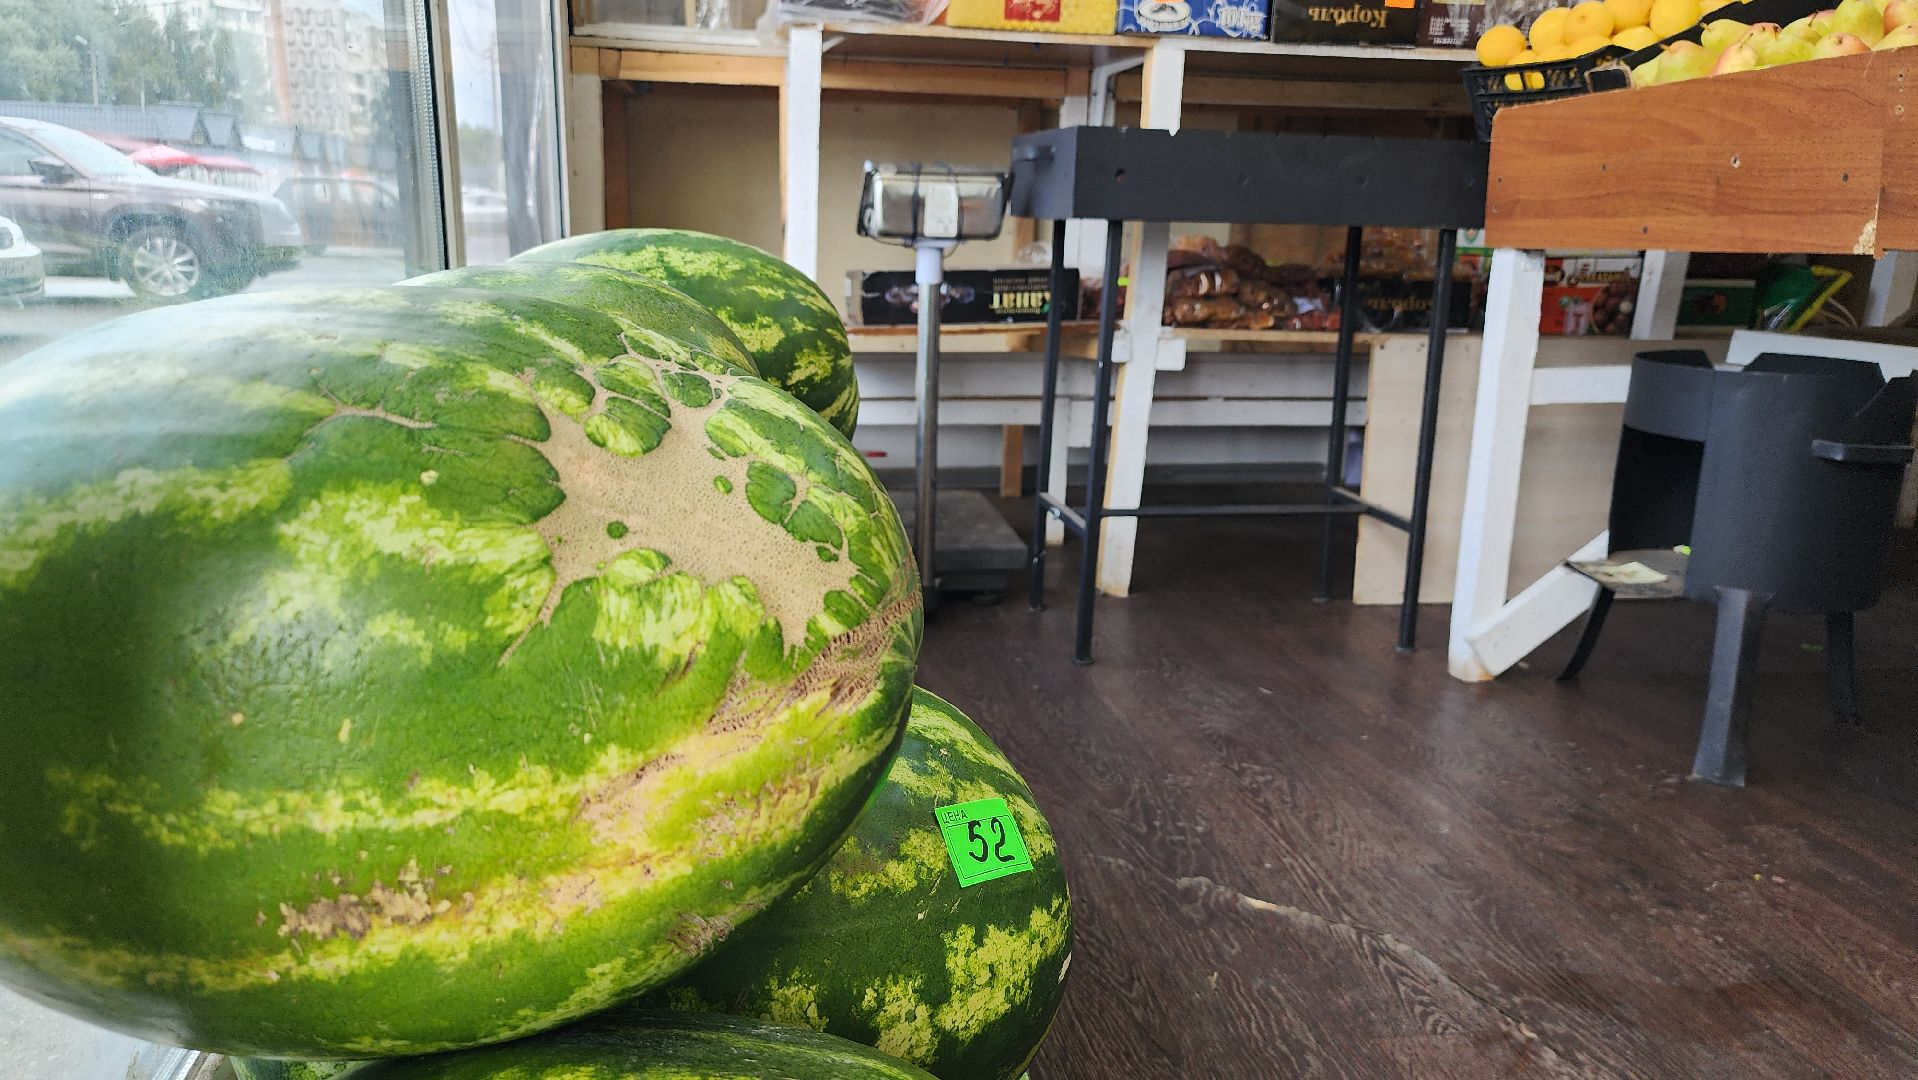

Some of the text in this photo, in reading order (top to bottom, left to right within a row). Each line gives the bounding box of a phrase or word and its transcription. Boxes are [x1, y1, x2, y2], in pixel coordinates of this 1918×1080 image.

[1308, 5, 1388, 28] Король
[940, 809, 968, 824] ЦЕНА
[967, 817, 1016, 863] 52
